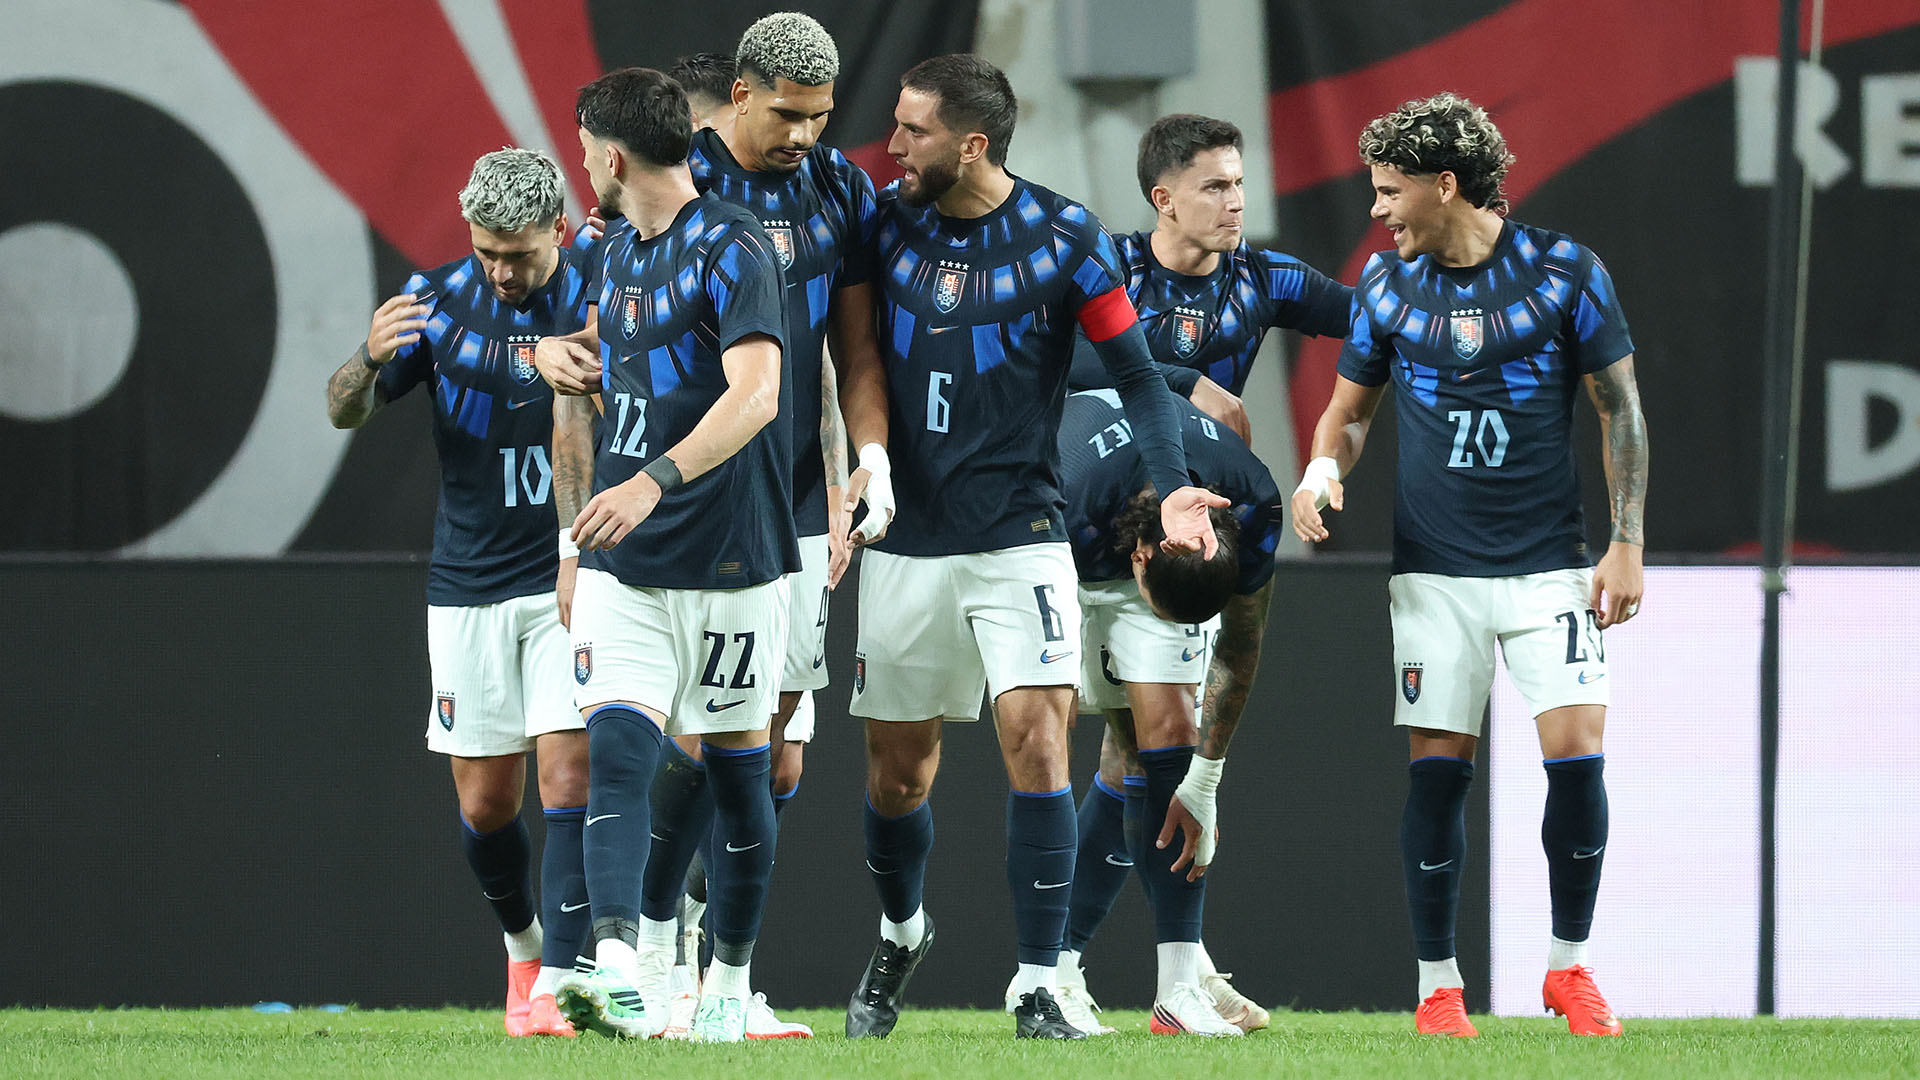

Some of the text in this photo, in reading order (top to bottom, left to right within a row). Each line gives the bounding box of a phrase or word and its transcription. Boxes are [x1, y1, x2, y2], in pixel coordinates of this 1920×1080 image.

[608, 392, 648, 459] 22
[926, 370, 952, 434] 6
[1447, 409, 1511, 468] 20
[499, 445, 552, 507] 10
[1033, 583, 1065, 643] 6
[699, 630, 756, 690] 22
